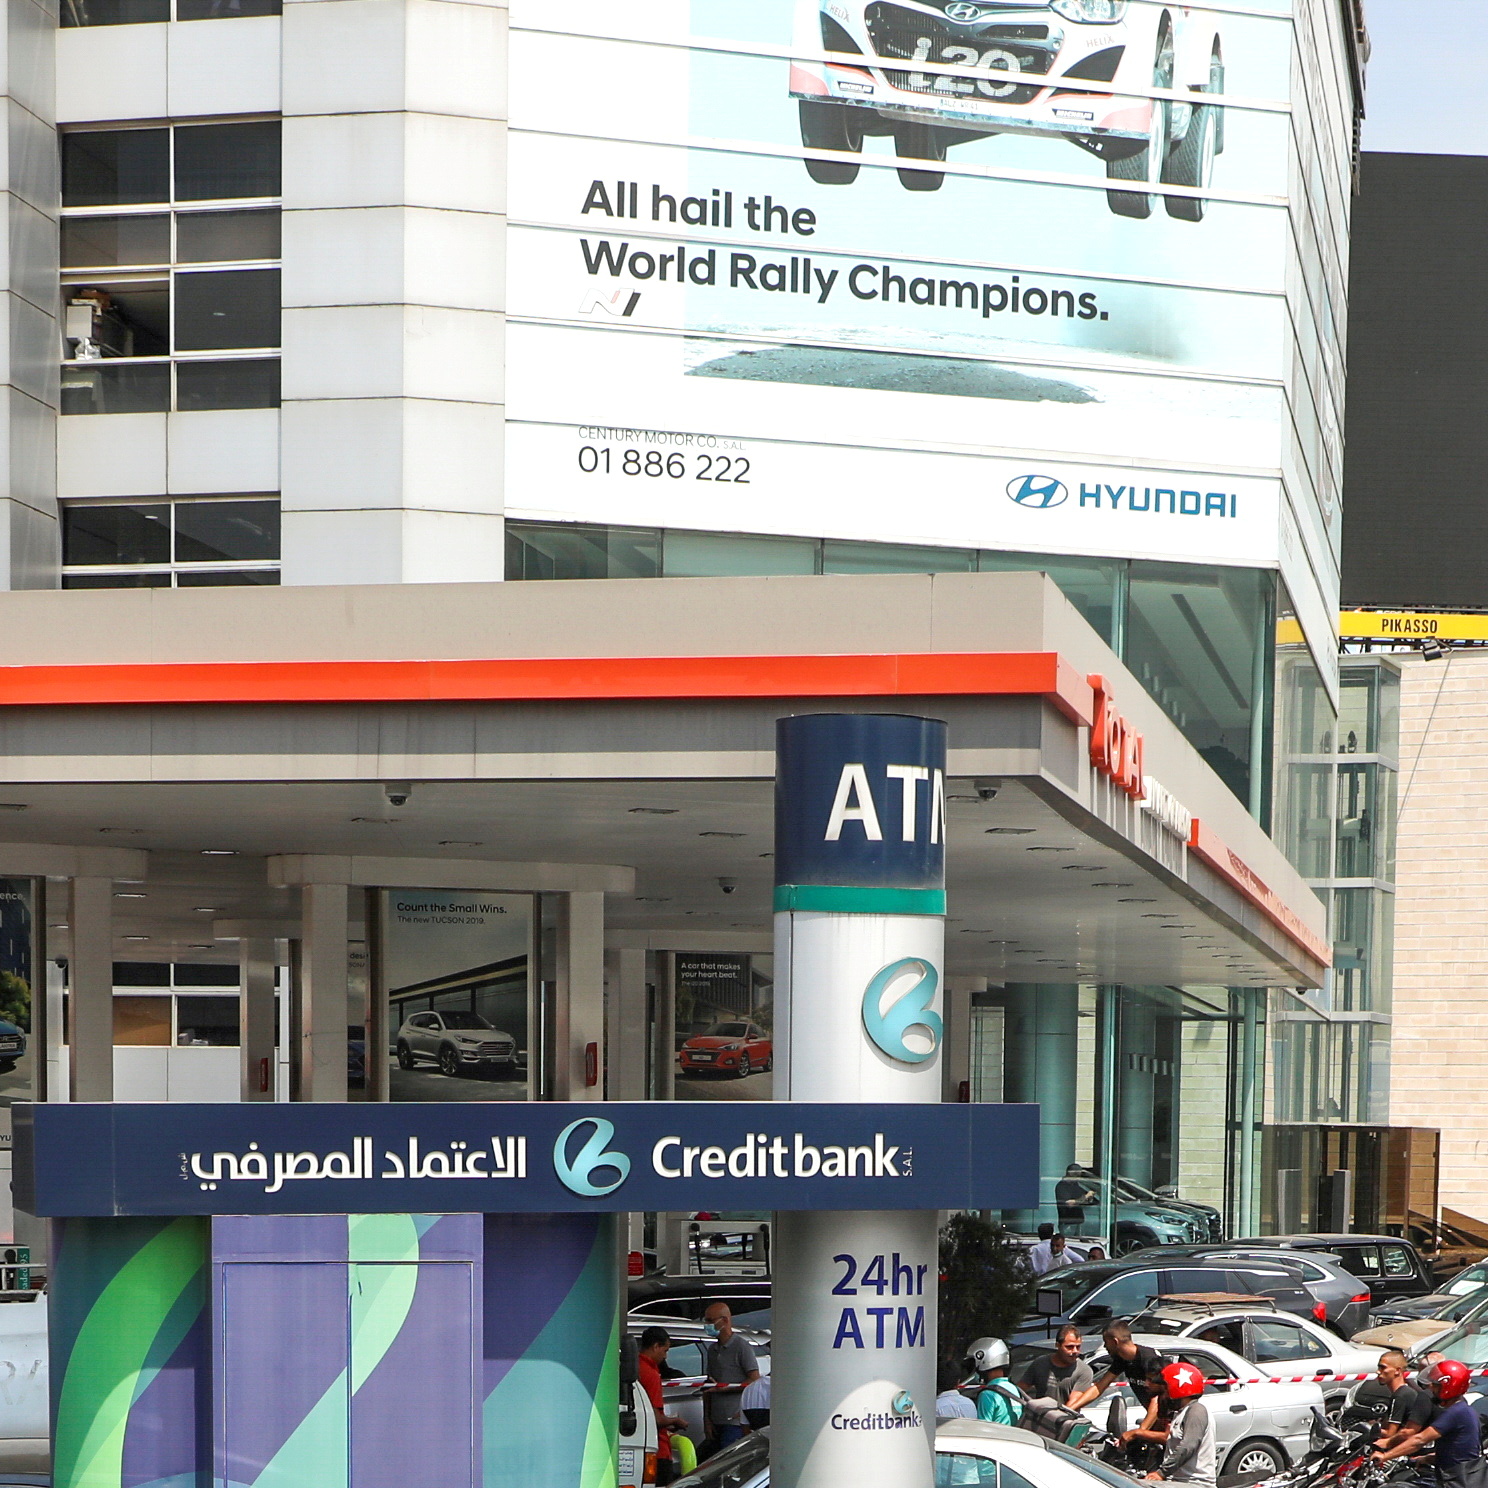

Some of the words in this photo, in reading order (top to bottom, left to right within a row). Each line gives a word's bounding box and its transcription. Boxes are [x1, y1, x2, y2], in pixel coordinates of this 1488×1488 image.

[581, 181, 639, 220] All
[652, 184, 734, 227] hail
[744, 195, 817, 236] the
[580, 239, 716, 286] World
[730, 253, 838, 305] Rally
[849, 264, 1110, 322] Champions.
[578, 426, 643, 442] CENTURY
[644, 431, 694, 447] MOTOR
[697, 434, 720, 448] CO.
[578, 446, 610, 474] 01
[622, 449, 686, 479] 886
[696, 454, 751, 484] 222
[1079, 481, 1238, 520] HYUNDAI
[1381, 617, 1439, 634] PIKASSO
[397, 902, 428, 913] Count
[430, 903, 447, 913] the
[449, 903, 478, 914] Small
[479, 904, 507, 914] Wins.
[431, 916, 465, 924] TUCSON
[681, 971, 697, 979] your
[698, 970, 718, 978] heart
[700, 962, 716, 970] that
[716, 963, 741, 971] makes
[191, 1136, 373, 1193] المصرفي
[381, 1135, 527, 1179] الاعتماد
[651, 1132, 901, 1179] Creditbank
[831, 1252, 928, 1296] 24hr
[832, 1305, 926, 1350] ATM
[830, 1411, 919, 1431] Creditbank
